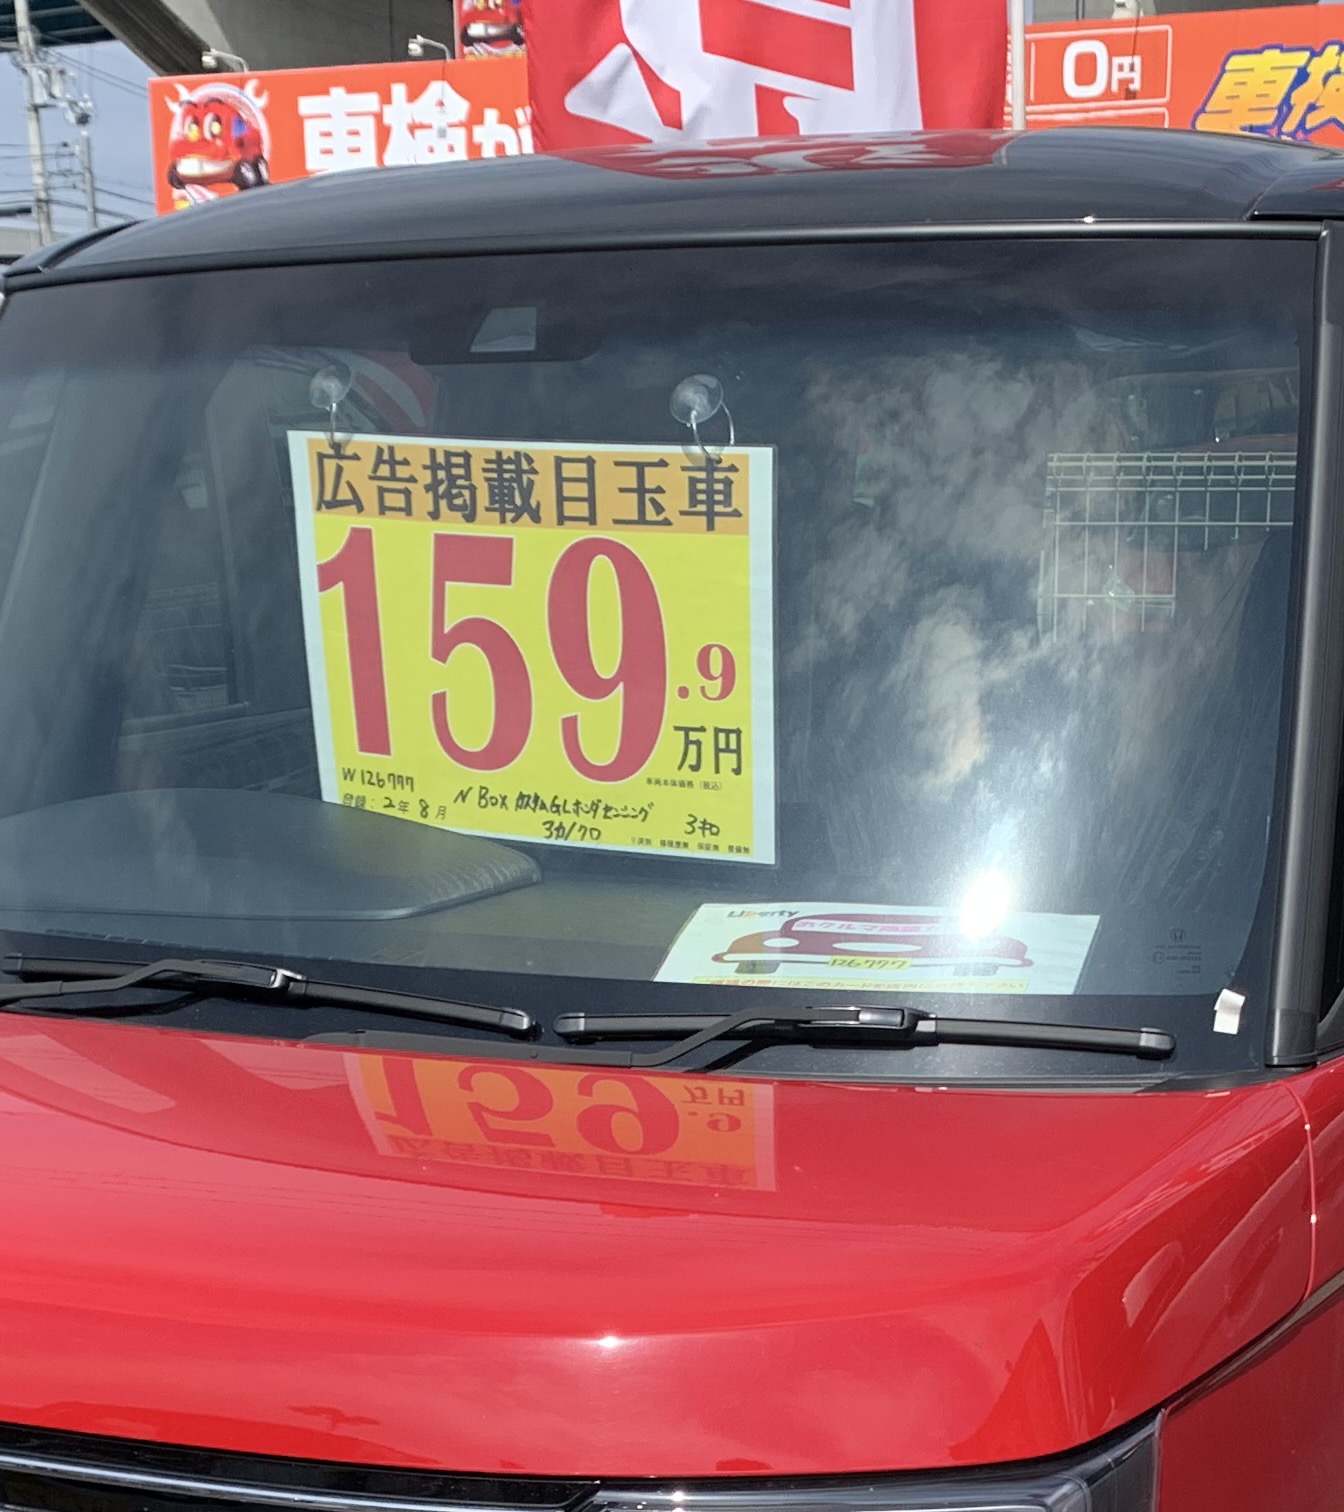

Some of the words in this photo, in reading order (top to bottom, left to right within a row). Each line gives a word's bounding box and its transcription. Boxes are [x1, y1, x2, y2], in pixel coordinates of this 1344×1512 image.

[1062, 39, 1143, 99] 0円
[314, 443, 744, 531] 広告掲載目玉車
[672, 724, 743, 777] 万円
[726, 909, 800, 919] Liberty
